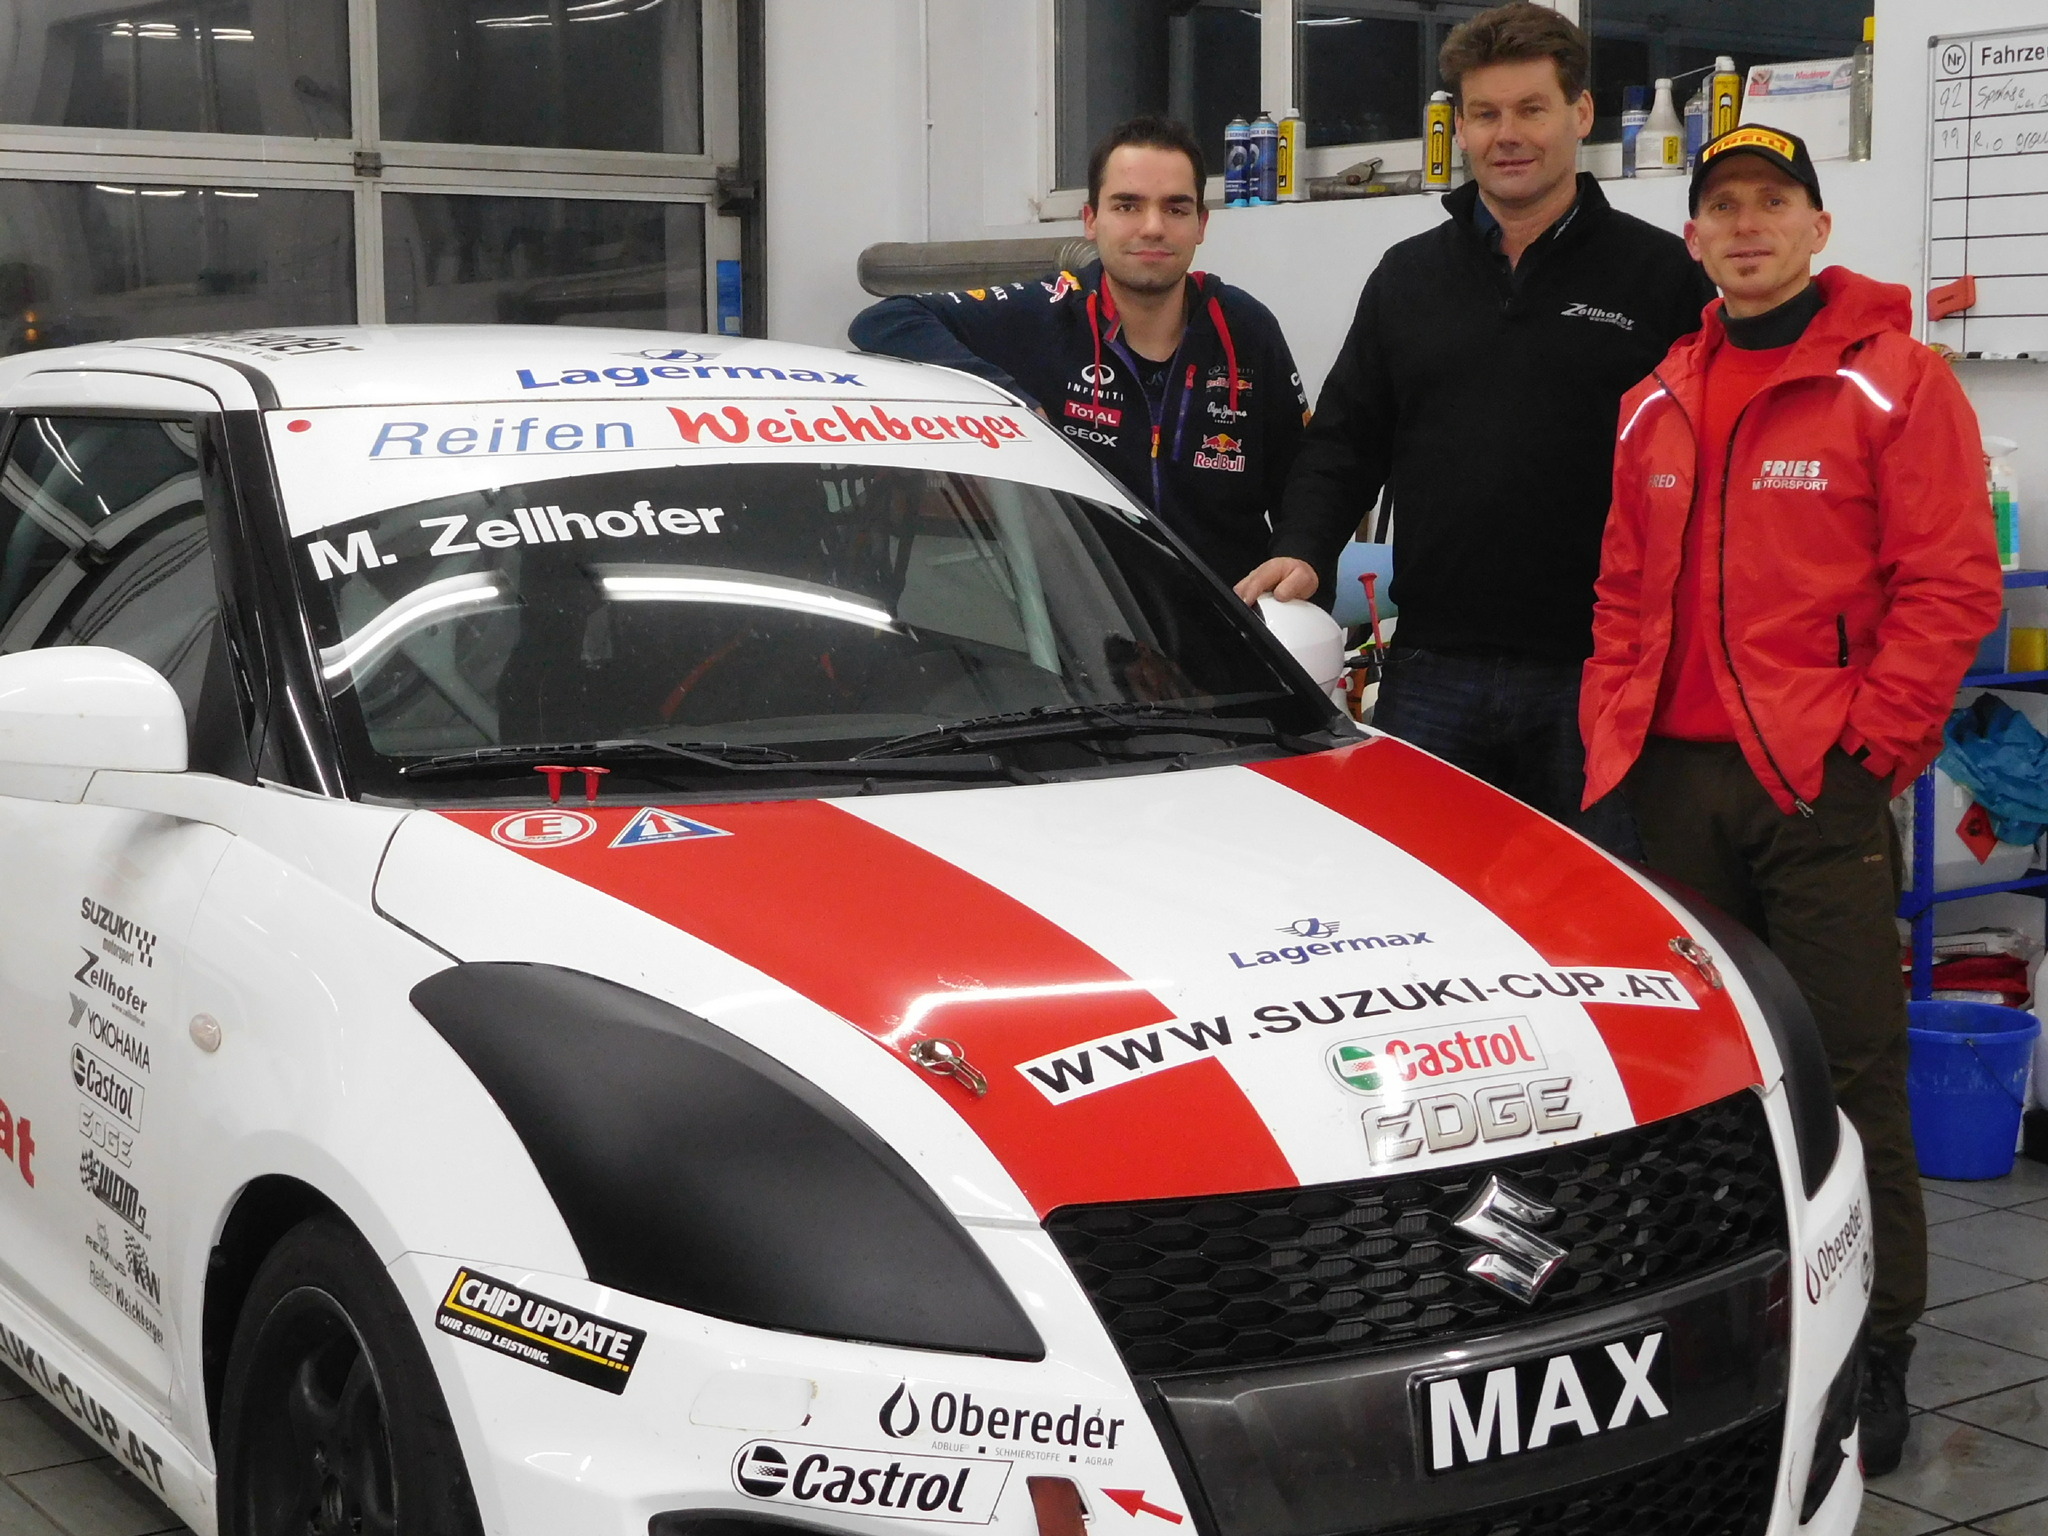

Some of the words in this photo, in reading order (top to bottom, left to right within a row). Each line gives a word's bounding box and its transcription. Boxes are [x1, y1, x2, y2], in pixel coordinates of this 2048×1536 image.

[1948, 53, 1962, 67] Nr
[1981, 45, 2048, 66] Fahrze
[1704, 130, 1790, 159] PIRELLI
[1560, 301, 1635, 326] Zellhofer
[516, 365, 867, 389] Lagermax
[1067, 381, 1124, 402] INFINITI
[369, 416, 634, 458] Reifen
[666, 404, 1028, 449] Weichberger
[1063, 425, 1119, 448] GEOX
[1069, 402, 1118, 424] TOTAL
[1752, 479, 1828, 491] MOTORSPORT
[1760, 460, 1821, 478] FRIES
[307, 530, 398, 581] M.
[420, 501, 725, 556] Zellhofer
[80, 896, 134, 945] SUZUKI
[1228, 932, 1435, 970] Lagermax
[74, 945, 148, 1015] Zellhofer
[86, 1007, 151, 1074] YOKOHAMA
[1384, 1024, 1536, 1082] Castrol
[85, 1058, 134, 1121] Castrol
[79, 1102, 134, 1169] EDGE
[1360, 1076, 1584, 1167] EDGE
[1817, 1198, 1864, 1282] Obereder
[114, 1281, 164, 1344] Weichberger
[459, 1278, 522, 1318] CHIP
[520, 1300, 633, 1361] UPDATE
[440, 1314, 462, 1331] WIR
[463, 1323, 491, 1342] SIND
[492, 1334, 550, 1365] LEISTUNG.
[931, 1391, 1125, 1450] Obereder
[1430, 1331, 1670, 1470] MAX
[994, 1447, 1061, 1462] SCHMIERSTOFFE
[1084, 1456, 1114, 1467] AGRAR
[792, 1453, 971, 1514] Castrol
